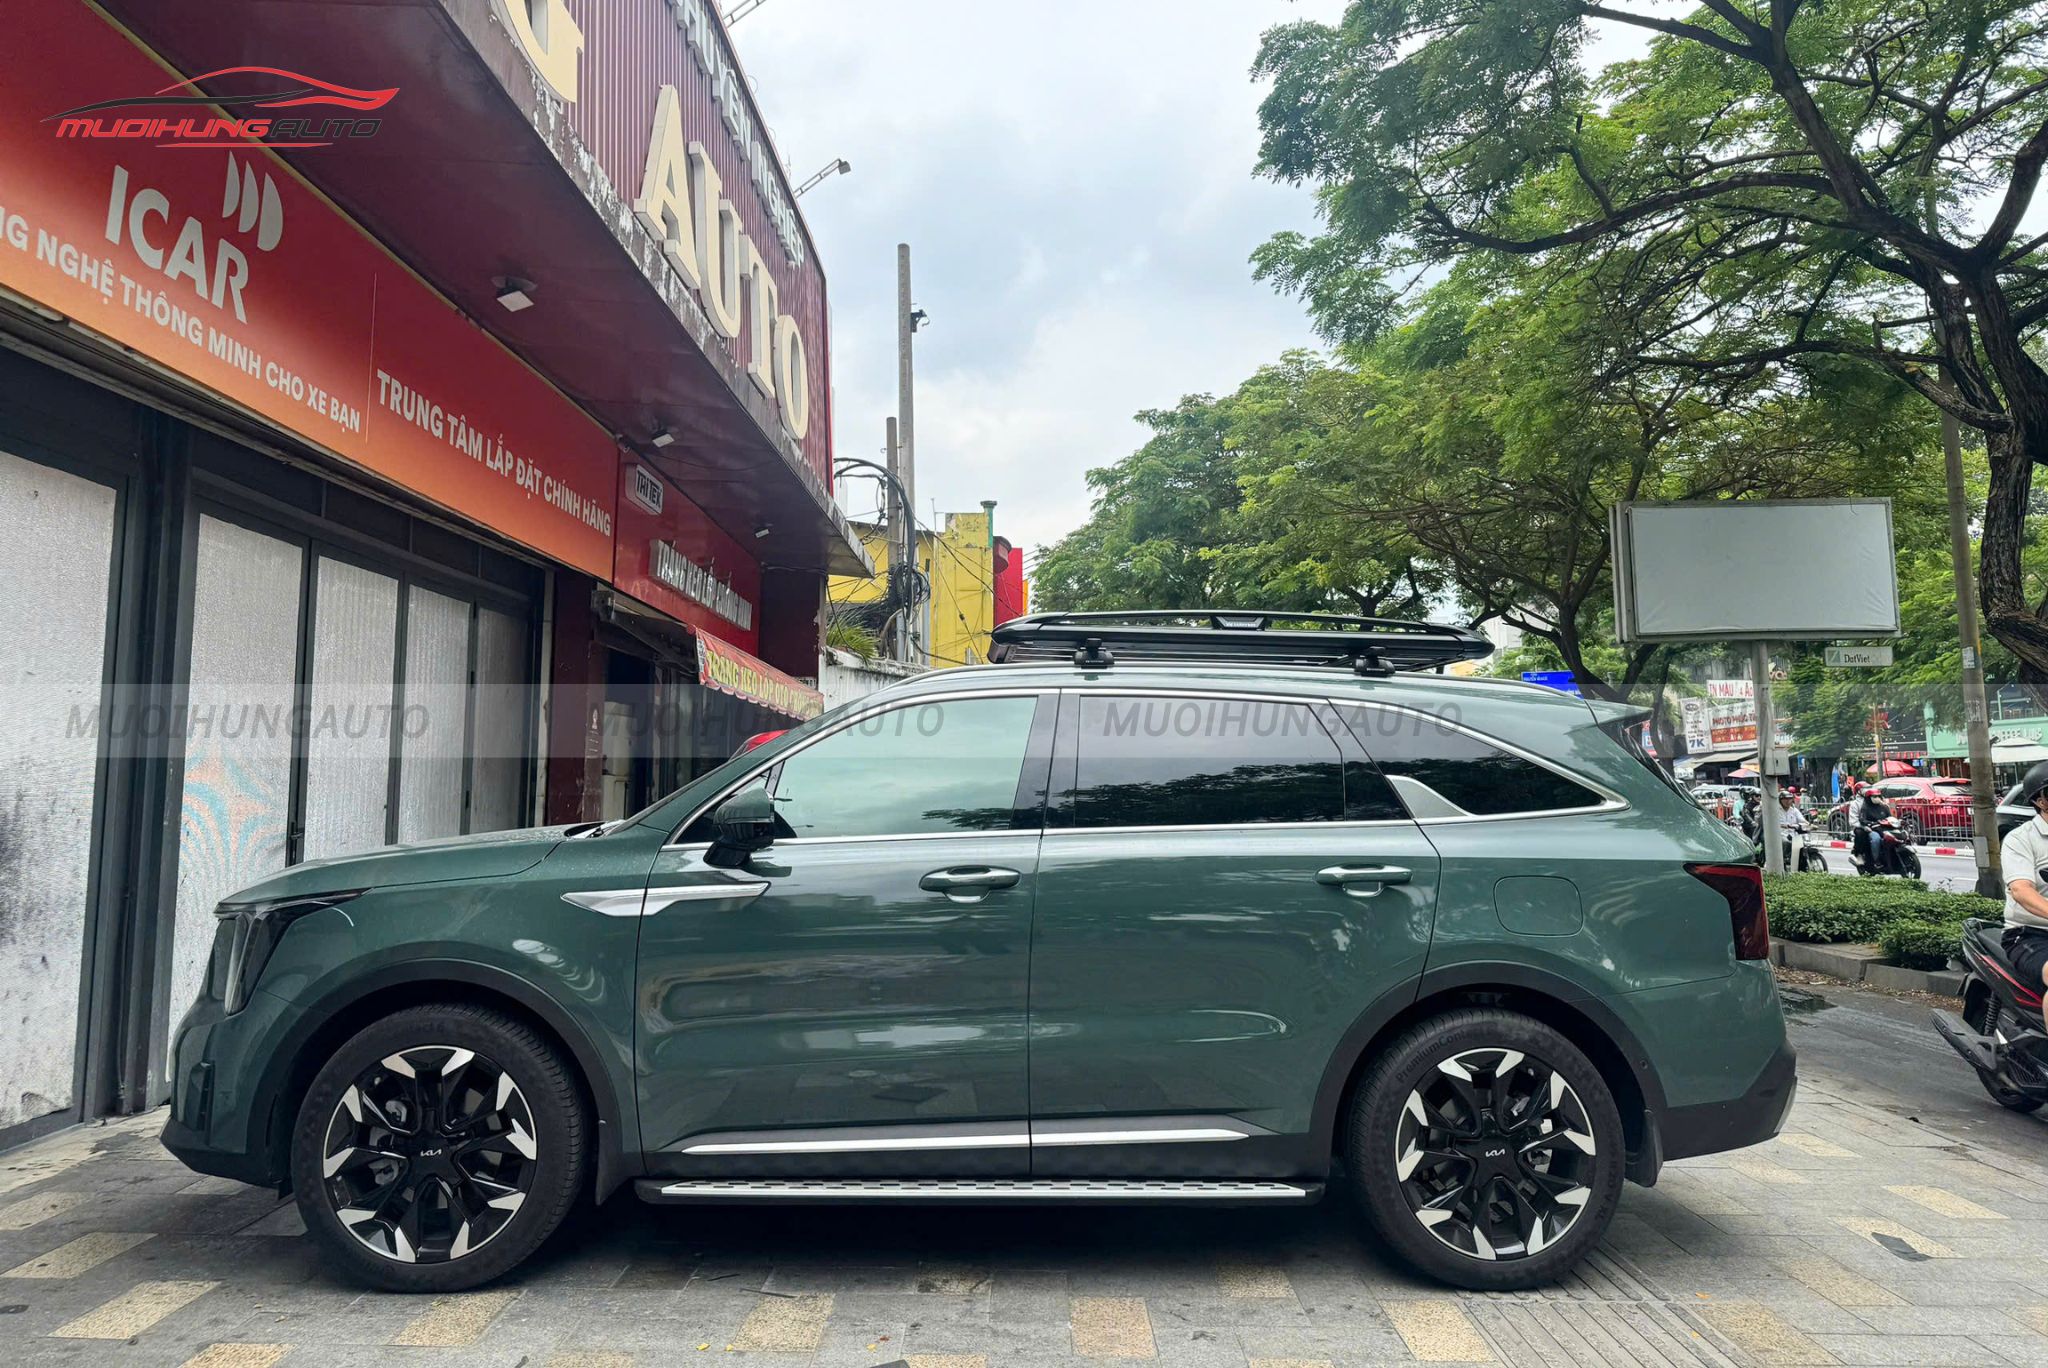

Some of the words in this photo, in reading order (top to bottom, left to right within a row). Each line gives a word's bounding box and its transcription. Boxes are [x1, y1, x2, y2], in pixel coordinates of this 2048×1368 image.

[670, 0, 751, 162] HUYÊN
[752, 141, 804, 270] NGHIỆP
[105, 164, 249, 325] ICAR
[634, 85, 809, 440] AUTO
[37, 227, 115, 304] NGHỆ
[120, 274, 203, 347] THÔNG
[208, 326, 262, 379] MINH
[265, 361, 304, 401] CHO
[307, 383, 327, 415] XE
[330, 393, 361, 434] BẠN
[376, 368, 444, 438] TRUNG
[446, 414, 484, 462] TÂM
[486, 432, 514, 479] LẮP
[516, 457, 542, 499] ĐẶT
[543, 472, 582, 520] CHÍNH
[583, 497, 611, 537] HÃNG
[1688, 738, 1705, 748] 7K
[420, 1148, 442, 1157] KIA
[1485, 1148, 1505, 1158] KIA
